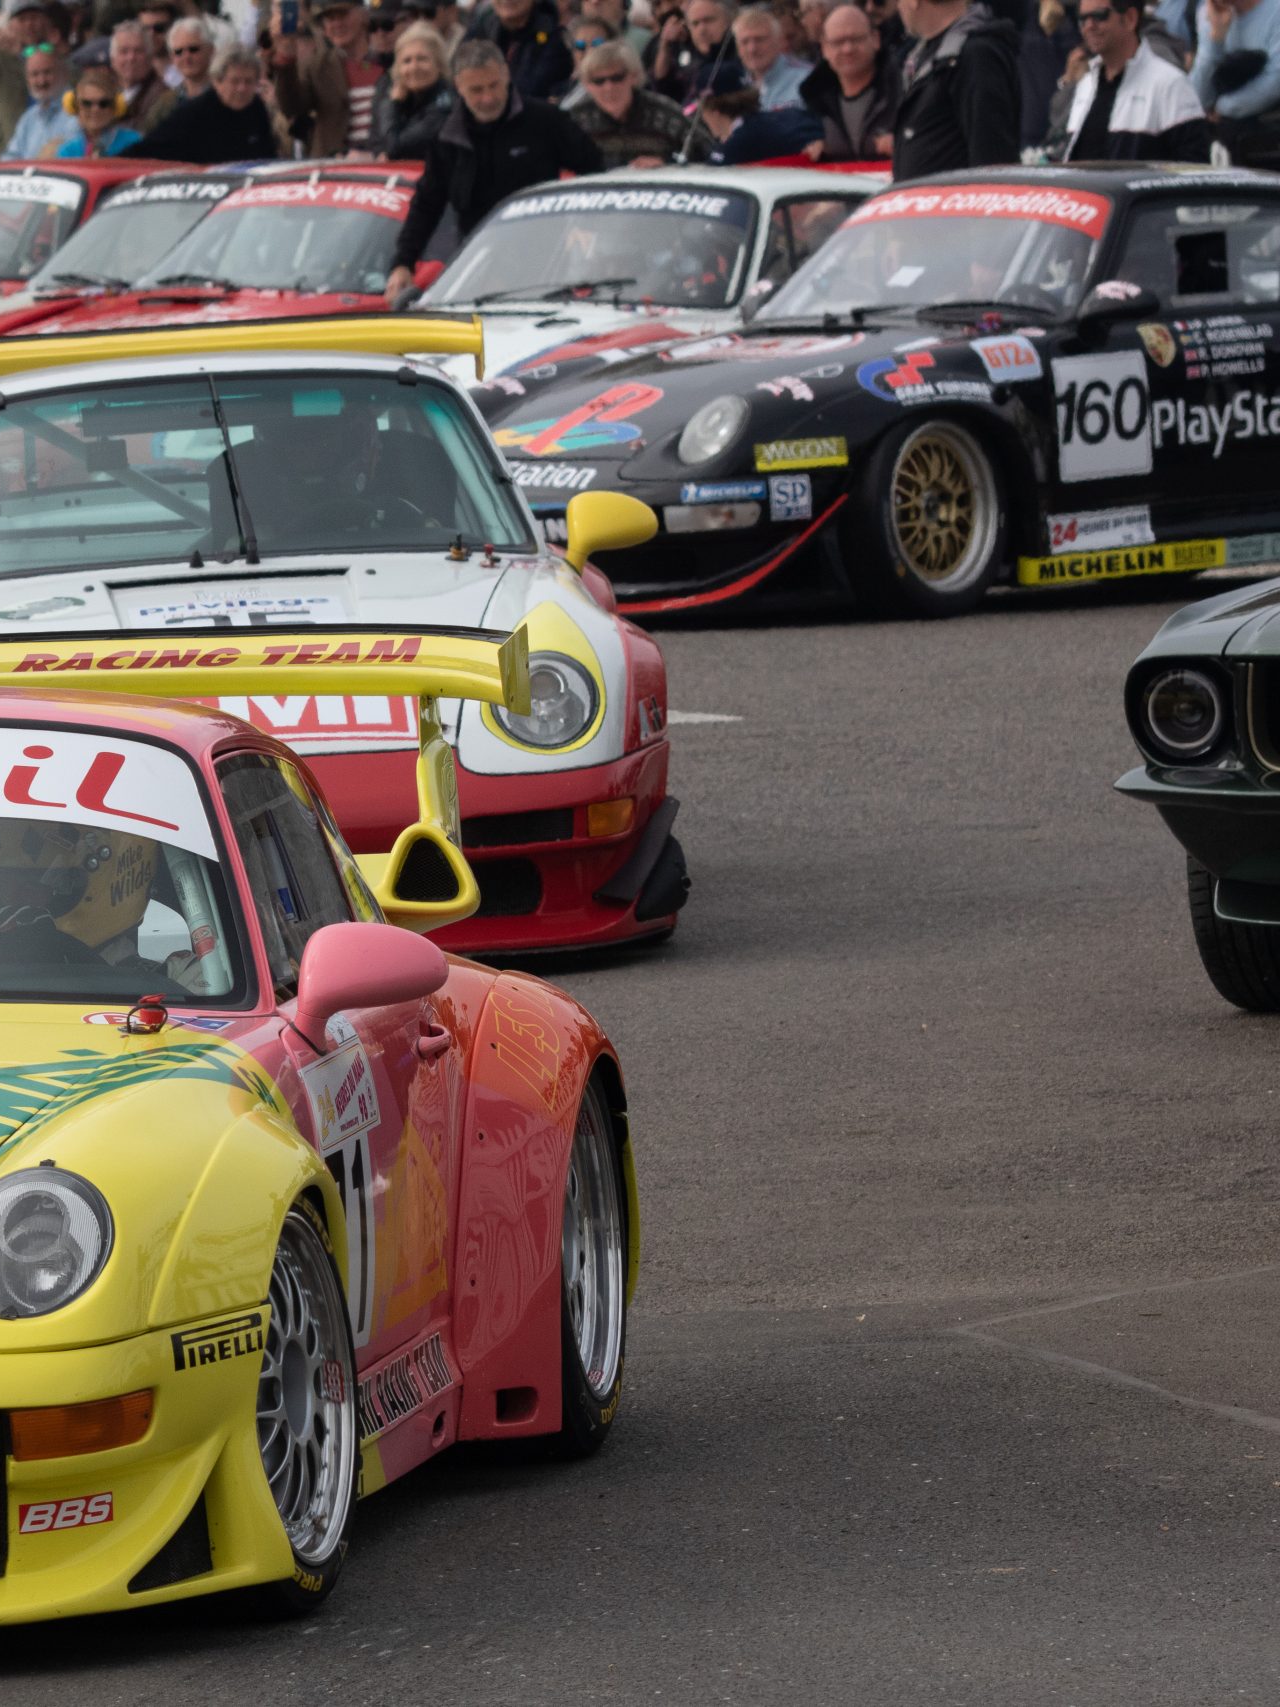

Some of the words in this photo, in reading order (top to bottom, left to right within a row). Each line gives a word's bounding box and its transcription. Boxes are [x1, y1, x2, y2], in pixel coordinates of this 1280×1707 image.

[1055, 377, 1148, 444] 160
[1052, 519, 1078, 545] 24
[1039, 550, 1164, 579] MICHELIN
[12, 646, 242, 673] RACING
[260, 636, 423, 666] TEAM
[117, 845, 144, 876] Mike
[171, 1312, 263, 1371] PIRELLI
[413, 1331, 454, 1398] TEAM
[20, 1493, 112, 1532] BBS
